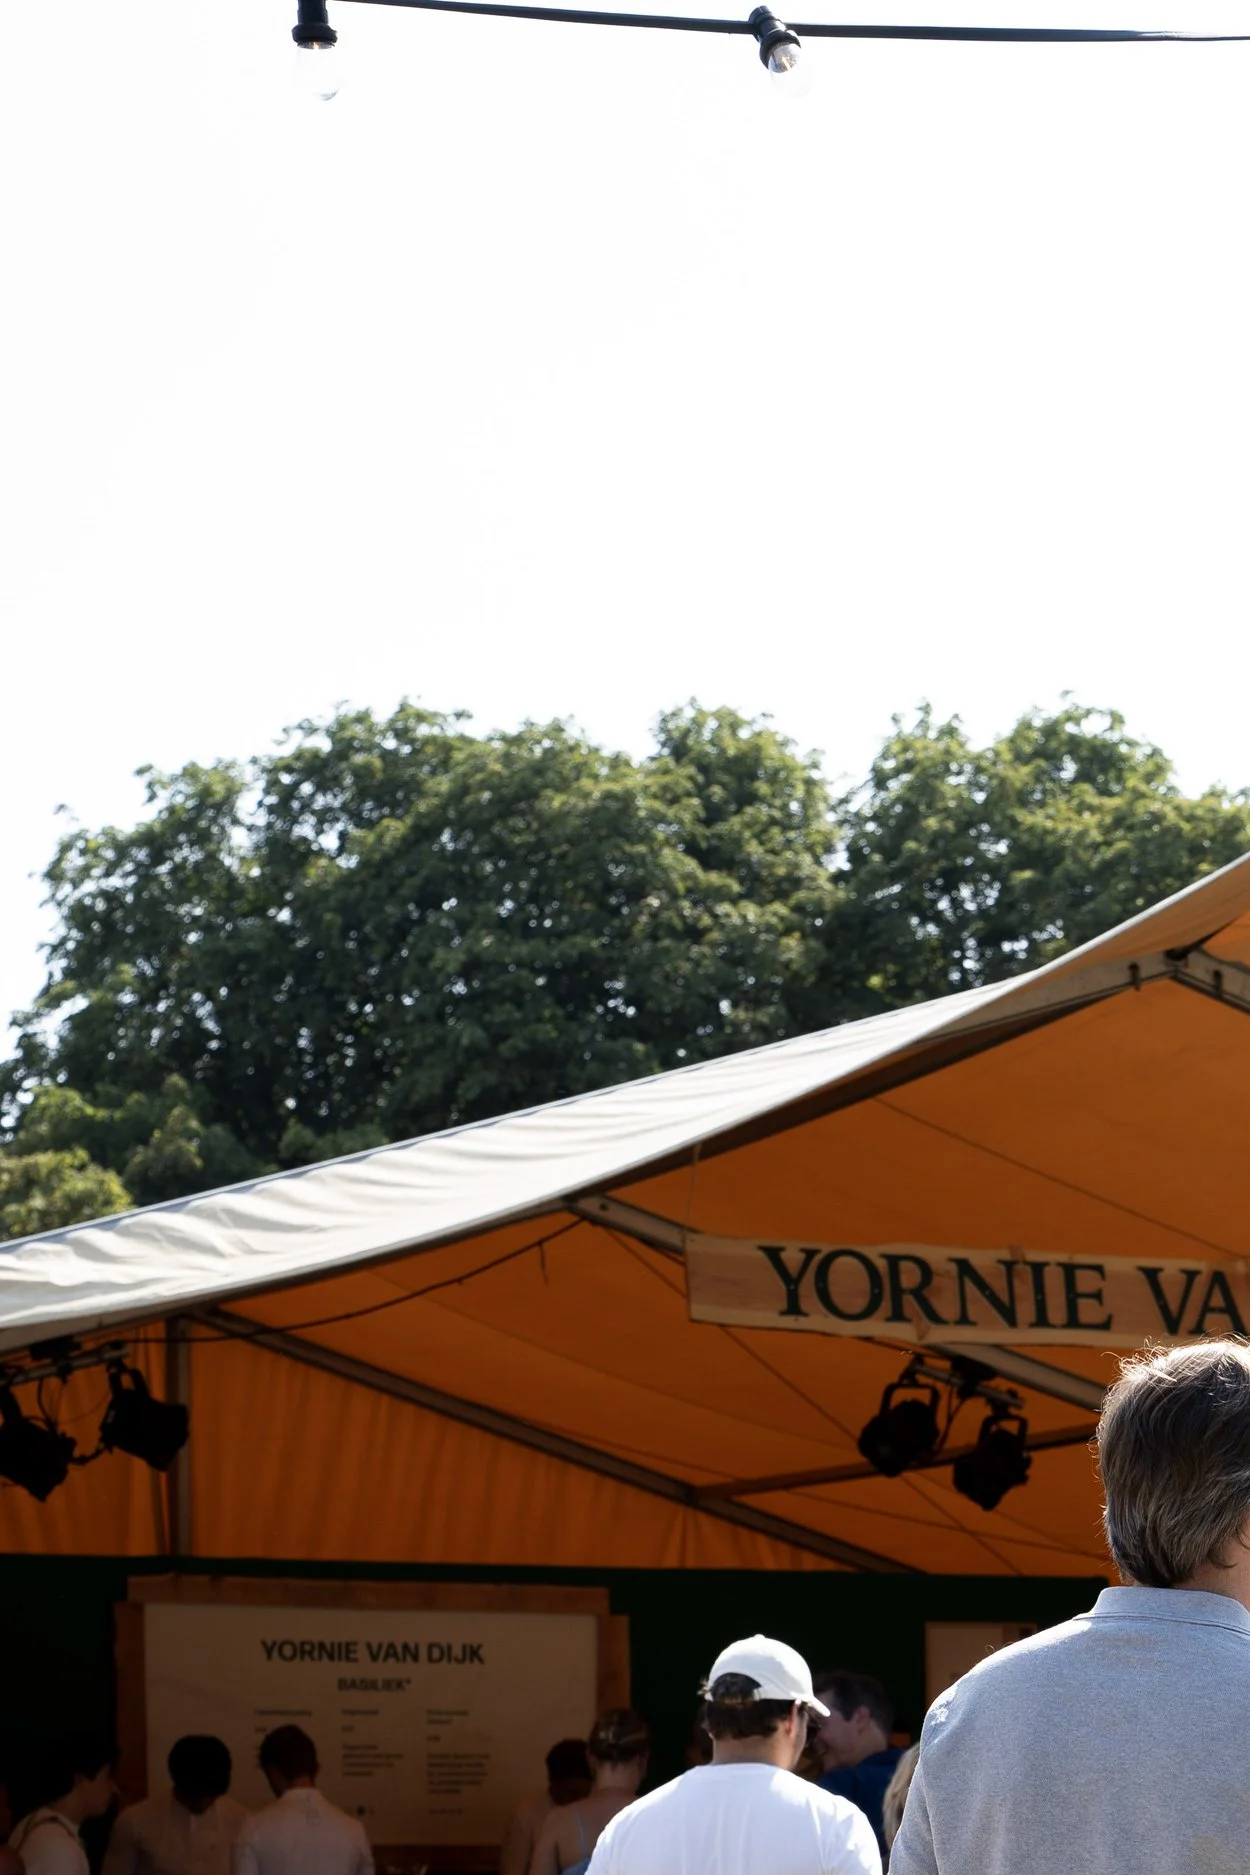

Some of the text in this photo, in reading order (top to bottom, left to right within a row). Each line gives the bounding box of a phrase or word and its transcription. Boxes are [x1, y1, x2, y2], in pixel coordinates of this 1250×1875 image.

[757, 1246, 1113, 1331] YORNIE
[261, 1639, 484, 1665] YORNIE VAN DIJK
